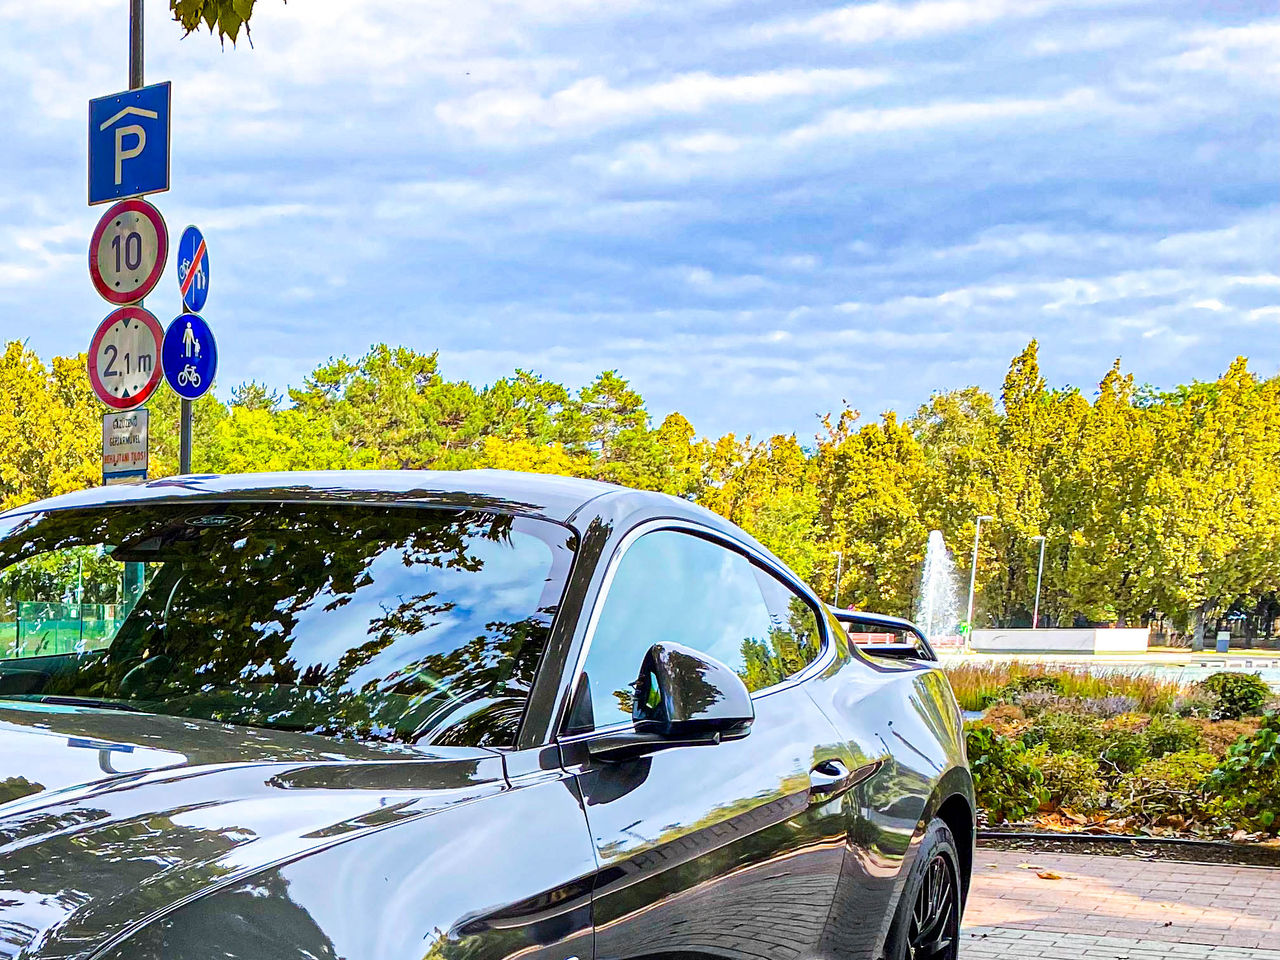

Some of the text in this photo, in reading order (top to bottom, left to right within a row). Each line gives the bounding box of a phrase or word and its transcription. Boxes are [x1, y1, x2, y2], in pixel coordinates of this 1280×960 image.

[115, 124, 147, 185] P
[111, 231, 142, 273] 10
[103, 344, 152, 378] 2.1 m
